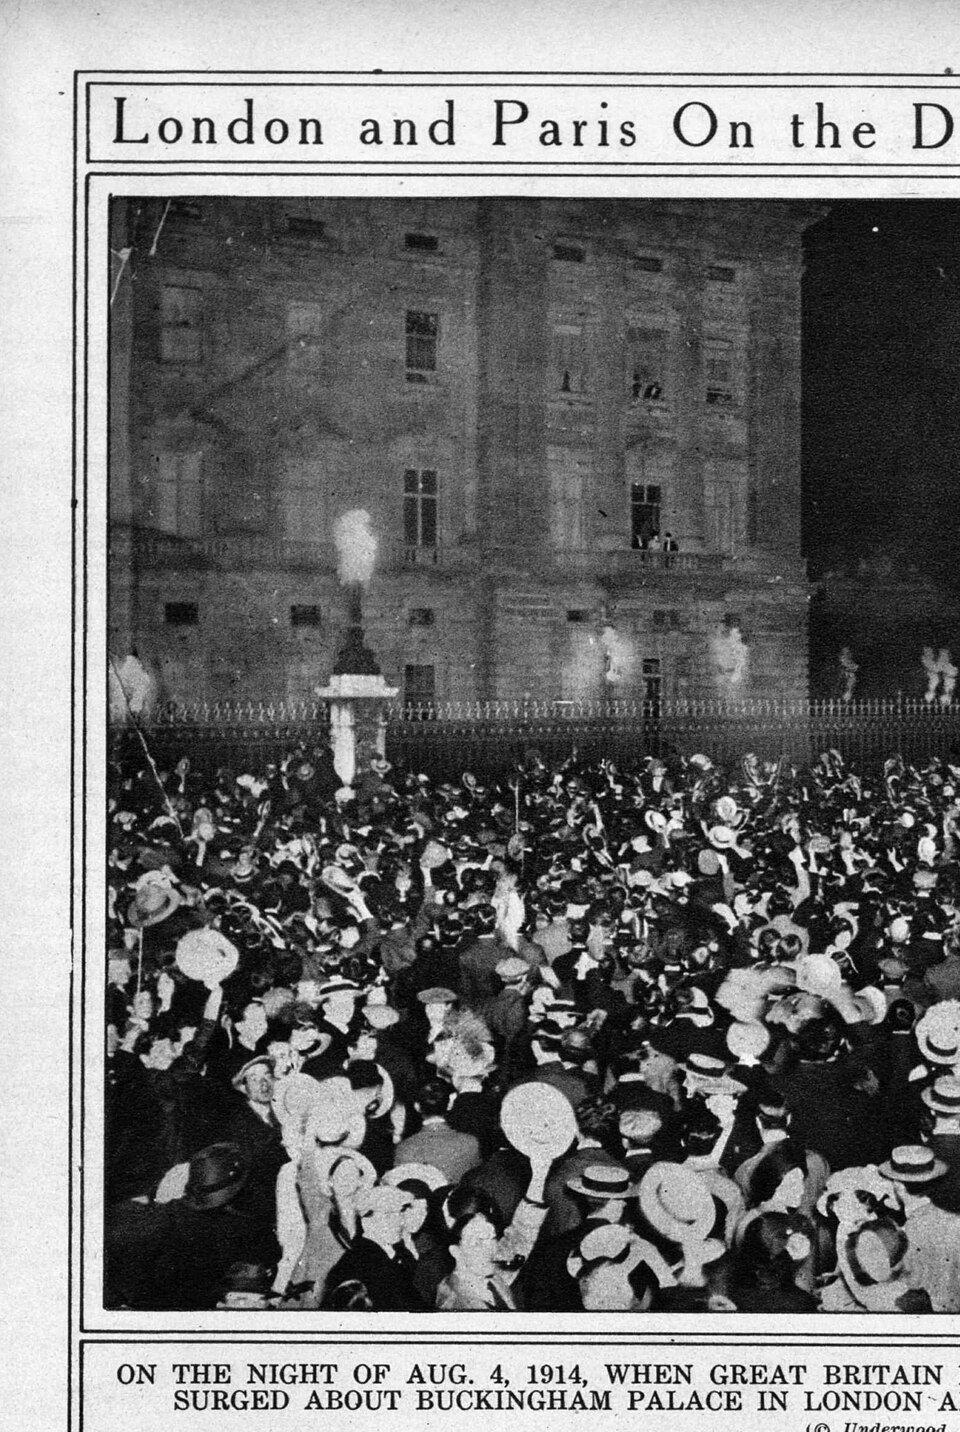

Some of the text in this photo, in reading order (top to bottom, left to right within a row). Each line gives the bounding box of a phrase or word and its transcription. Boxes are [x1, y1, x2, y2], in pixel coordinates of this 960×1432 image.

[112, 96, 324, 145] London
[359, 99, 456, 146] and
[492, 99, 637, 147] Paris
[672, 101, 754, 148] On
[790, 101, 876, 149] the
[116, 1363, 158, 1385] ON
[172, 1363, 232, 1385] THE
[246, 1363, 338, 1385] NIGHT
[353, 1363, 391, 1385] OF
[405, 1363, 474, 1385] AUG.
[489, 1363, 510, 1389] 4,
[527, 1364, 588, 1389] 1914,
[603, 1363, 694, 1385] WHEN
[709, 1364, 807, 1386] GREAT
[822, 1364, 944, 1386] BRITAIN
[173, 1389, 290, 1412] SURGED
[303, 1389, 402, 1411] ABOUT
[415, 1389, 613, 1411] BUCKINGHAM
[626, 1390, 743, 1412] PALACE
[757, 1390, 789, 1412] IN
[803, 1390, 923, 1412] LONDON
